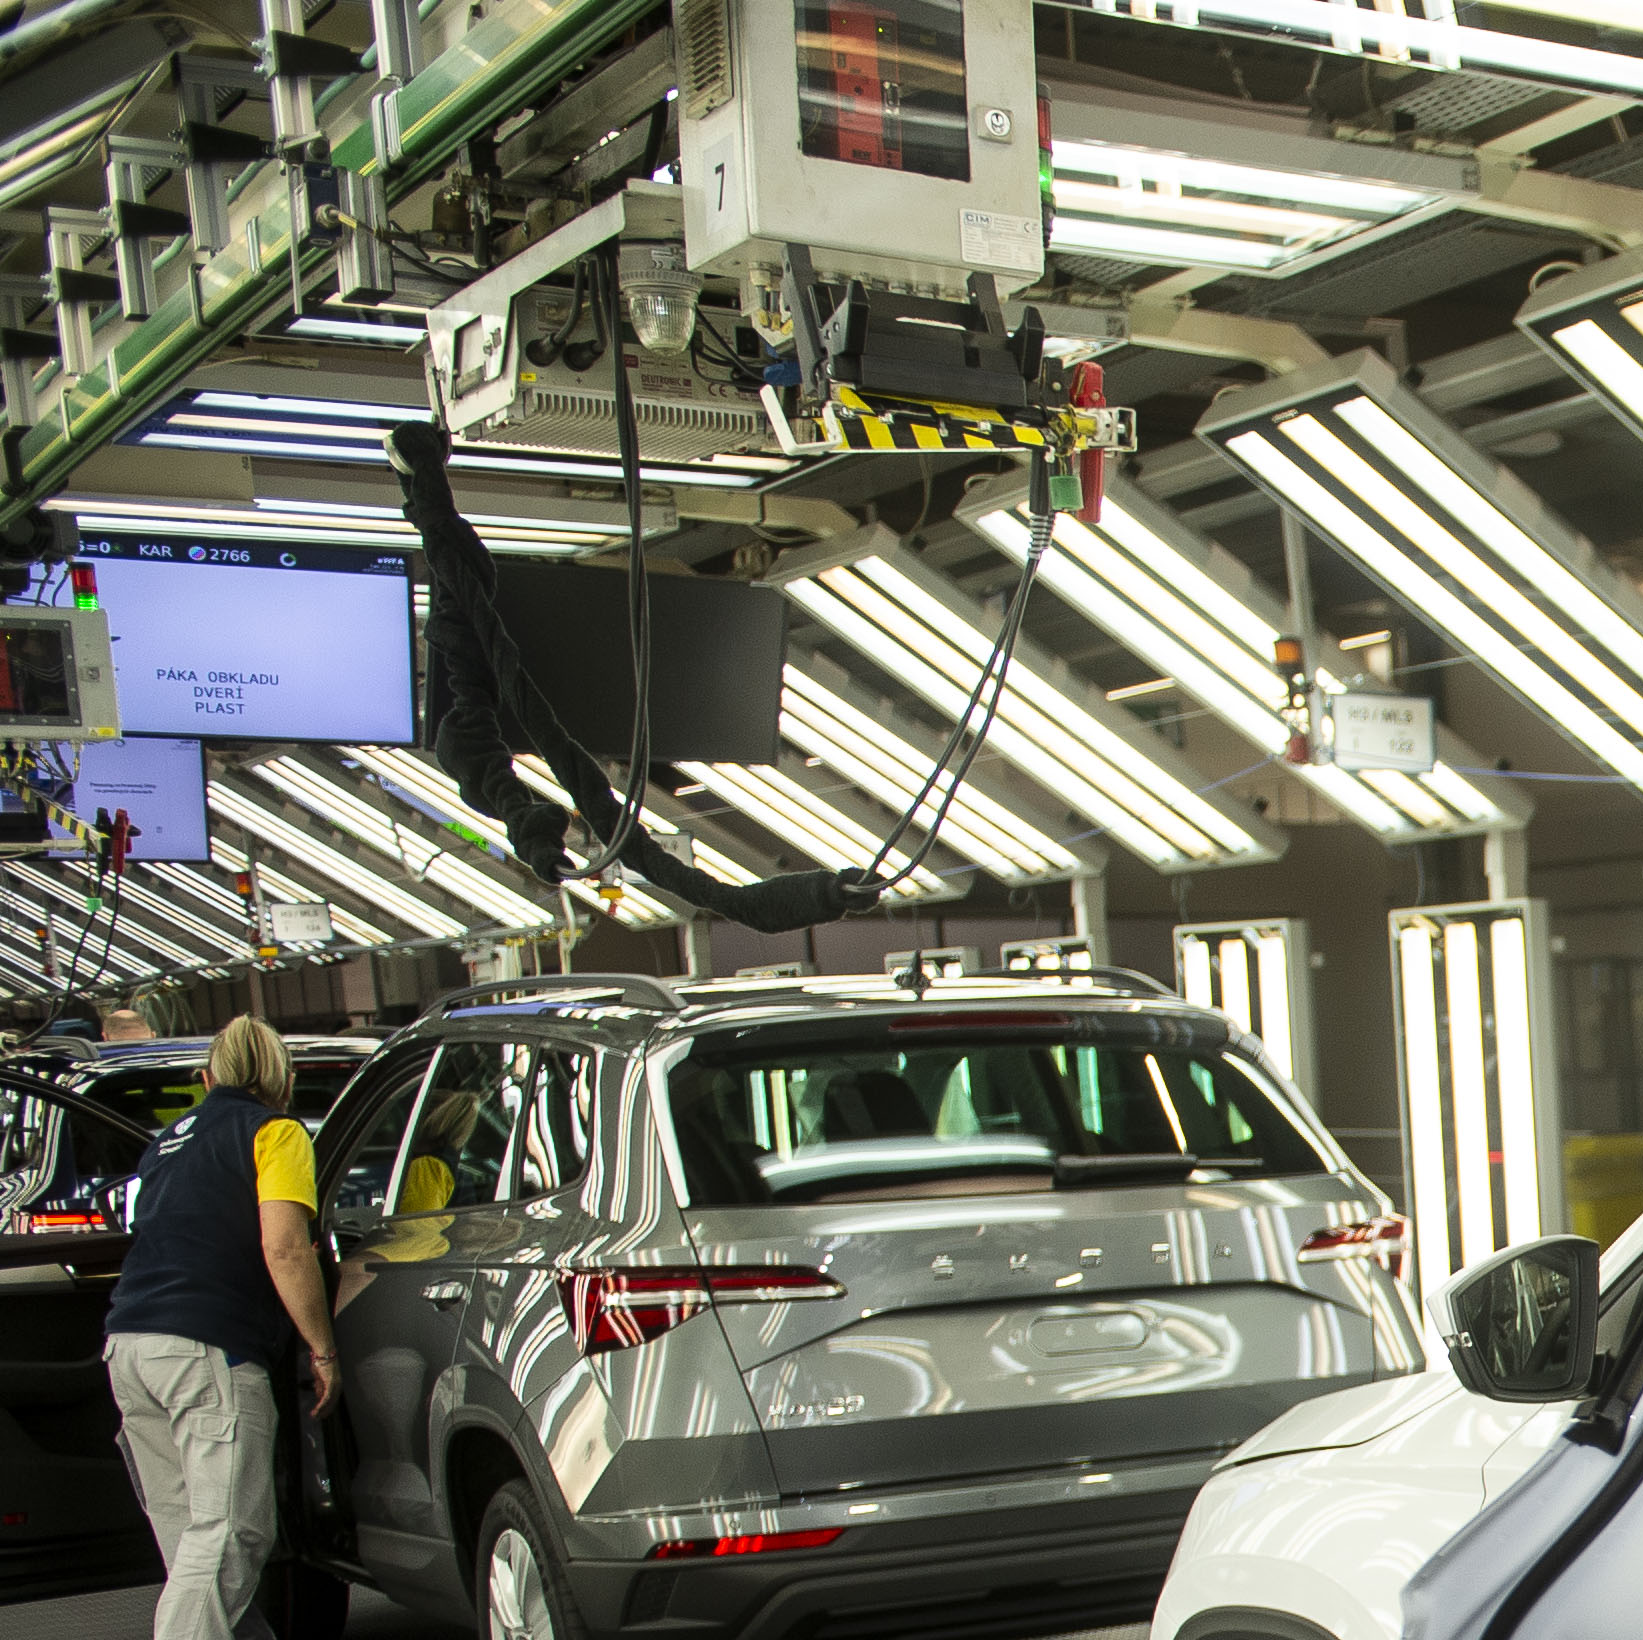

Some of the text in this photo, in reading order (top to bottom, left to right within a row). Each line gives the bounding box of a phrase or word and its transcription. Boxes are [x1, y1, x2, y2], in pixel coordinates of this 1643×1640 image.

[715, 162, 725, 212] 7
[966, 213, 990, 223] CIM
[641, 374, 682, 386] DEUTRONIC
[139, 544, 173, 558] KAR
[210, 548, 250, 562] 2766
[156, 667, 279, 686] PÁKA OBKLADU
[193, 686, 244, 700] DVERÍ
[195, 701, 245, 715] PLAST
